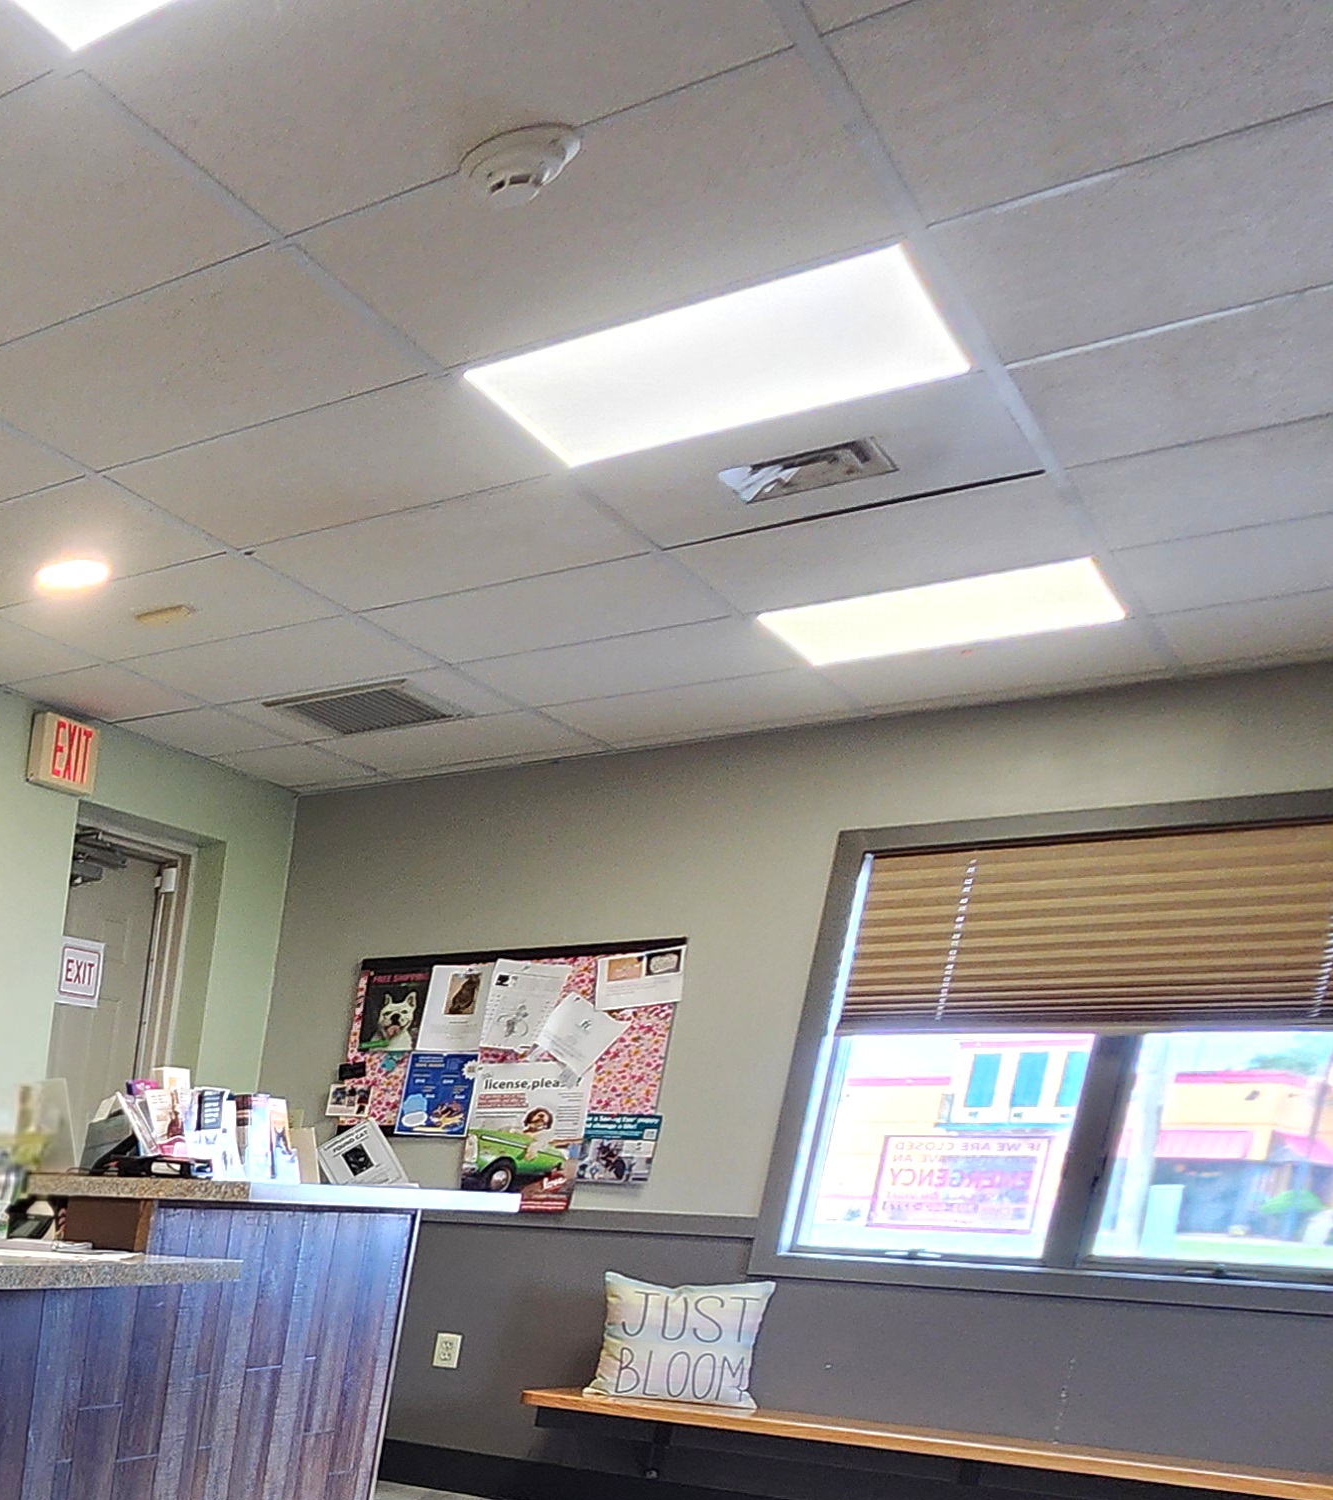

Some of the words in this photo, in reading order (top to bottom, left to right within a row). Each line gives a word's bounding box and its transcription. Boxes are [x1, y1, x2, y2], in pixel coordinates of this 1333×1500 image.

[51, 719, 94, 784] EXIT
[64, 958, 95, 986] EXIT
[353, 1130, 369, 1143] CAT
[621, 1290, 761, 1344] JUST
[614, 1347, 748, 1402] BLOOM
